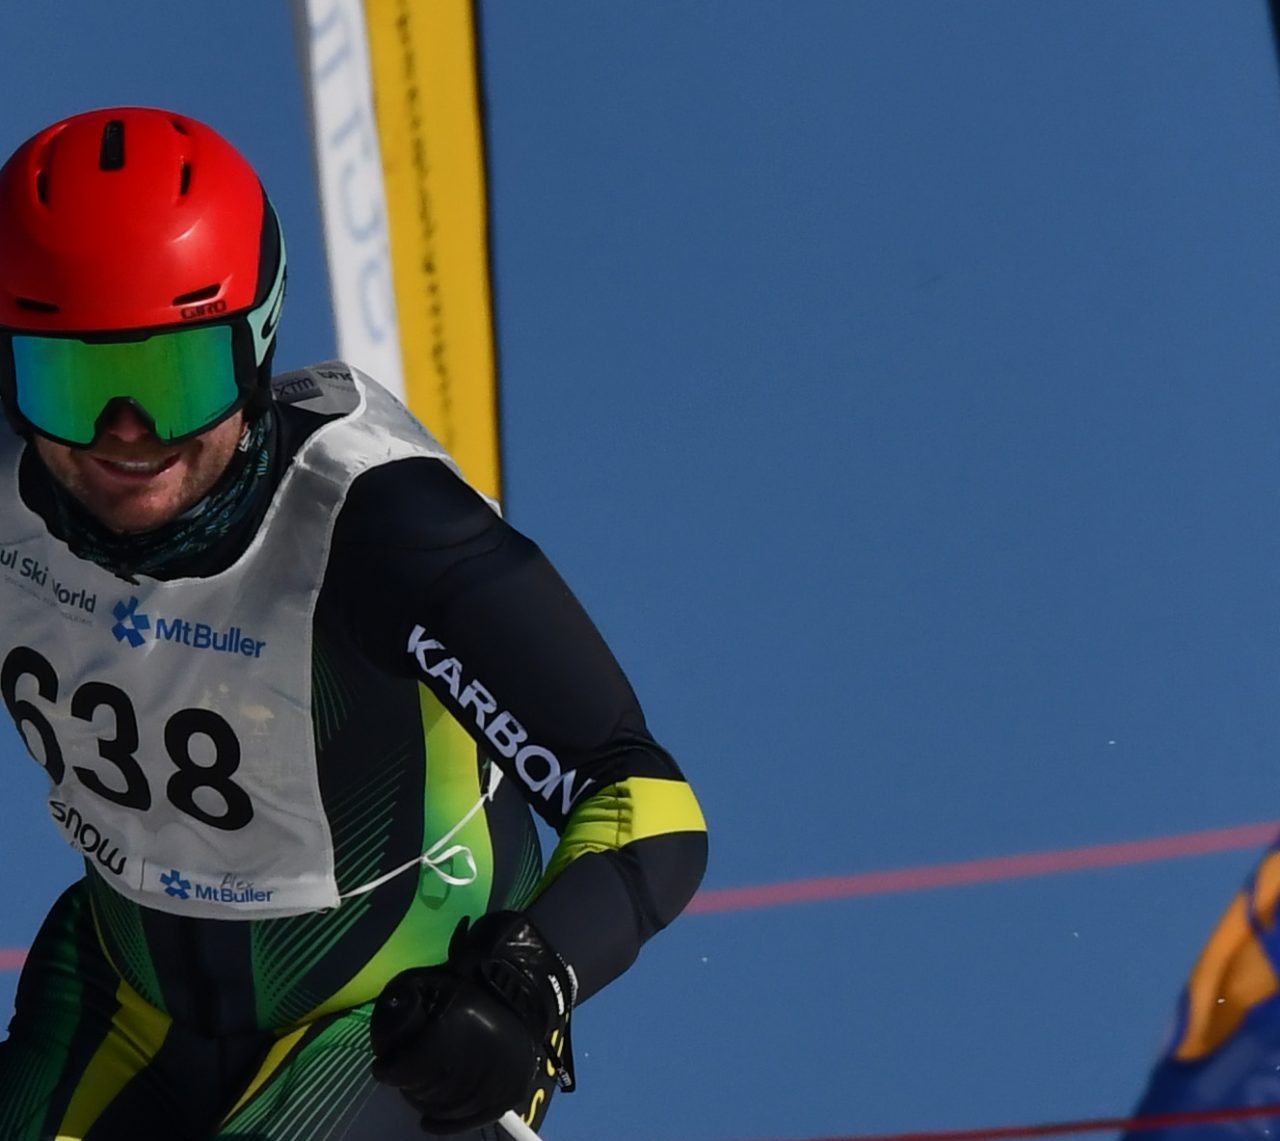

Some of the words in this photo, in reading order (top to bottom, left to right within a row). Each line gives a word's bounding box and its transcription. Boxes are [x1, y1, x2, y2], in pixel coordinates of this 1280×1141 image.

[181, 300, 227, 319] GIRO
[20, 558, 49, 586] Ski
[0, 646, 254, 831] 638
[50, 801, 127, 875] snow
